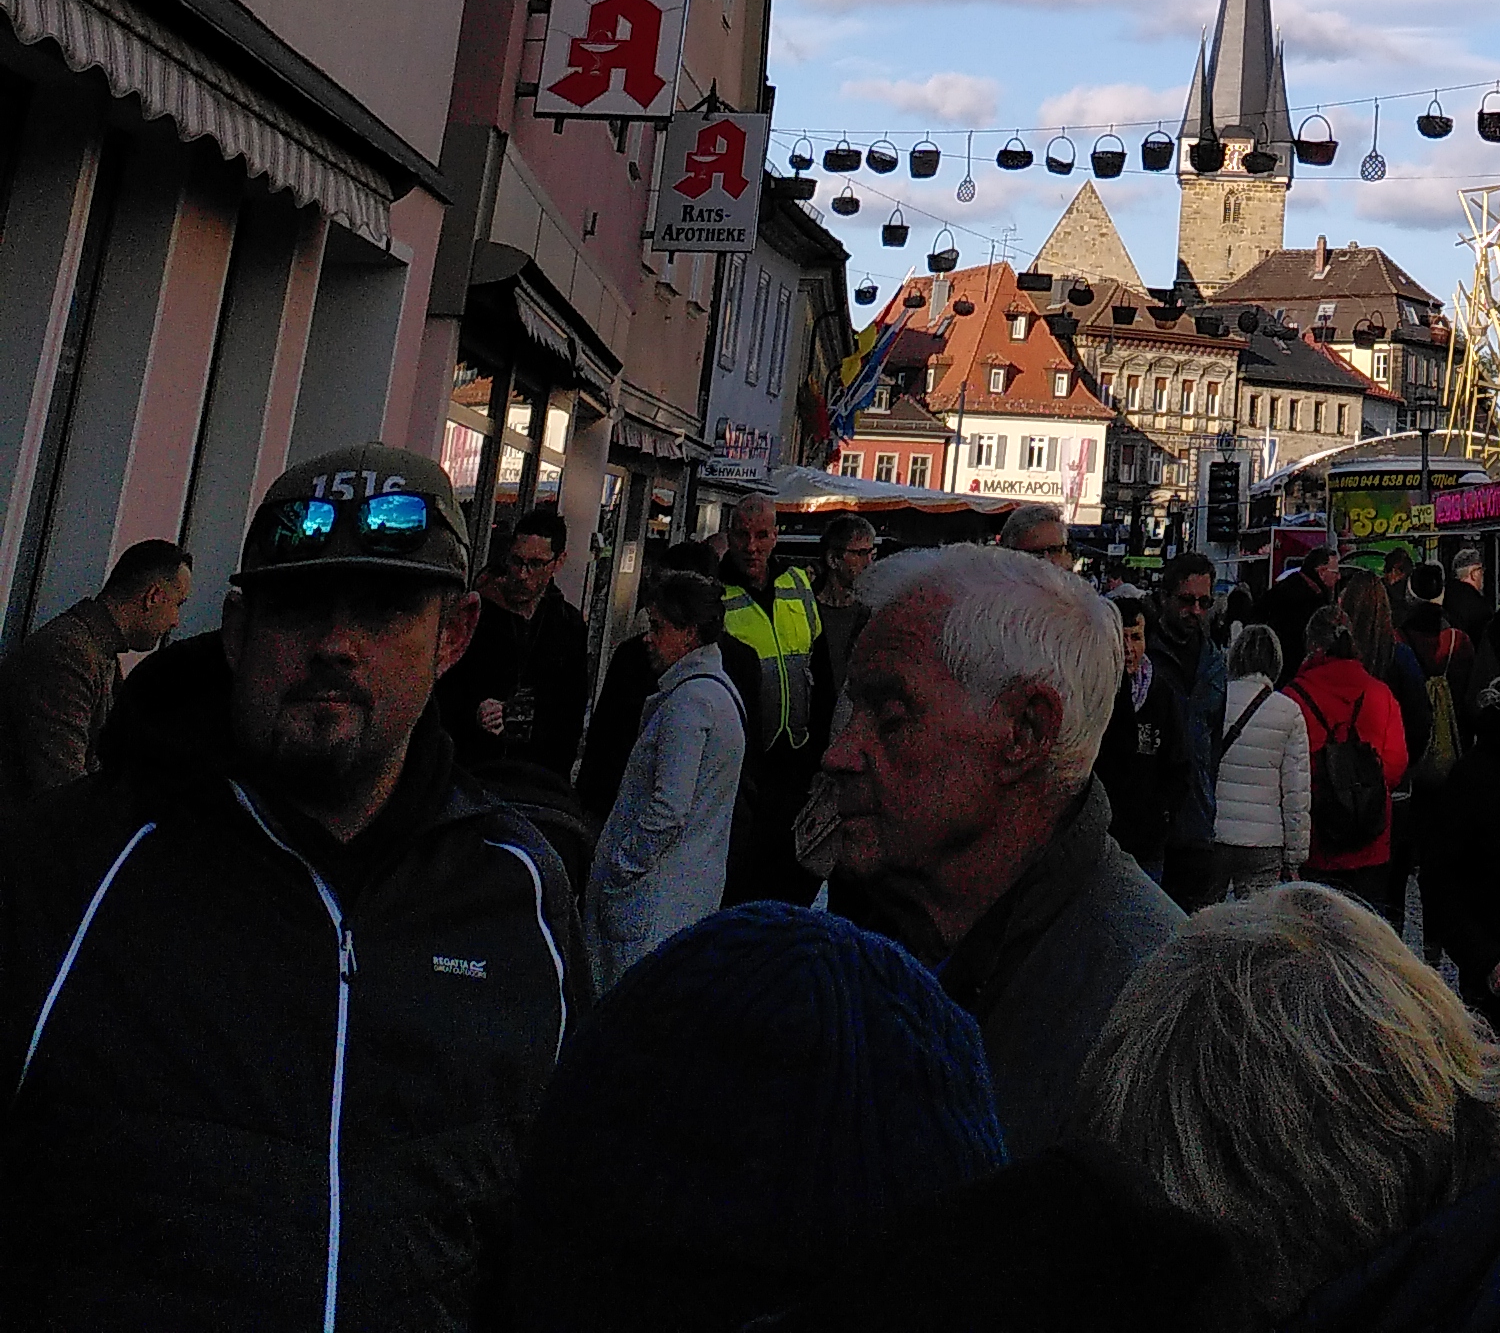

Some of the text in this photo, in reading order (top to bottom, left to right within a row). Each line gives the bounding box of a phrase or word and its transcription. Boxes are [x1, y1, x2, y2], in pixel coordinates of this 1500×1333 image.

[682, 205, 731, 222] RATS-
[662, 224, 746, 242] APOTHEKE
[705, 467, 757, 477] SCHWAHN
[983, 479, 1063, 495] MARKT-APOTH
[1417, 507, 1432, 517] WC
[433, 956, 468, 969] REGATTA
